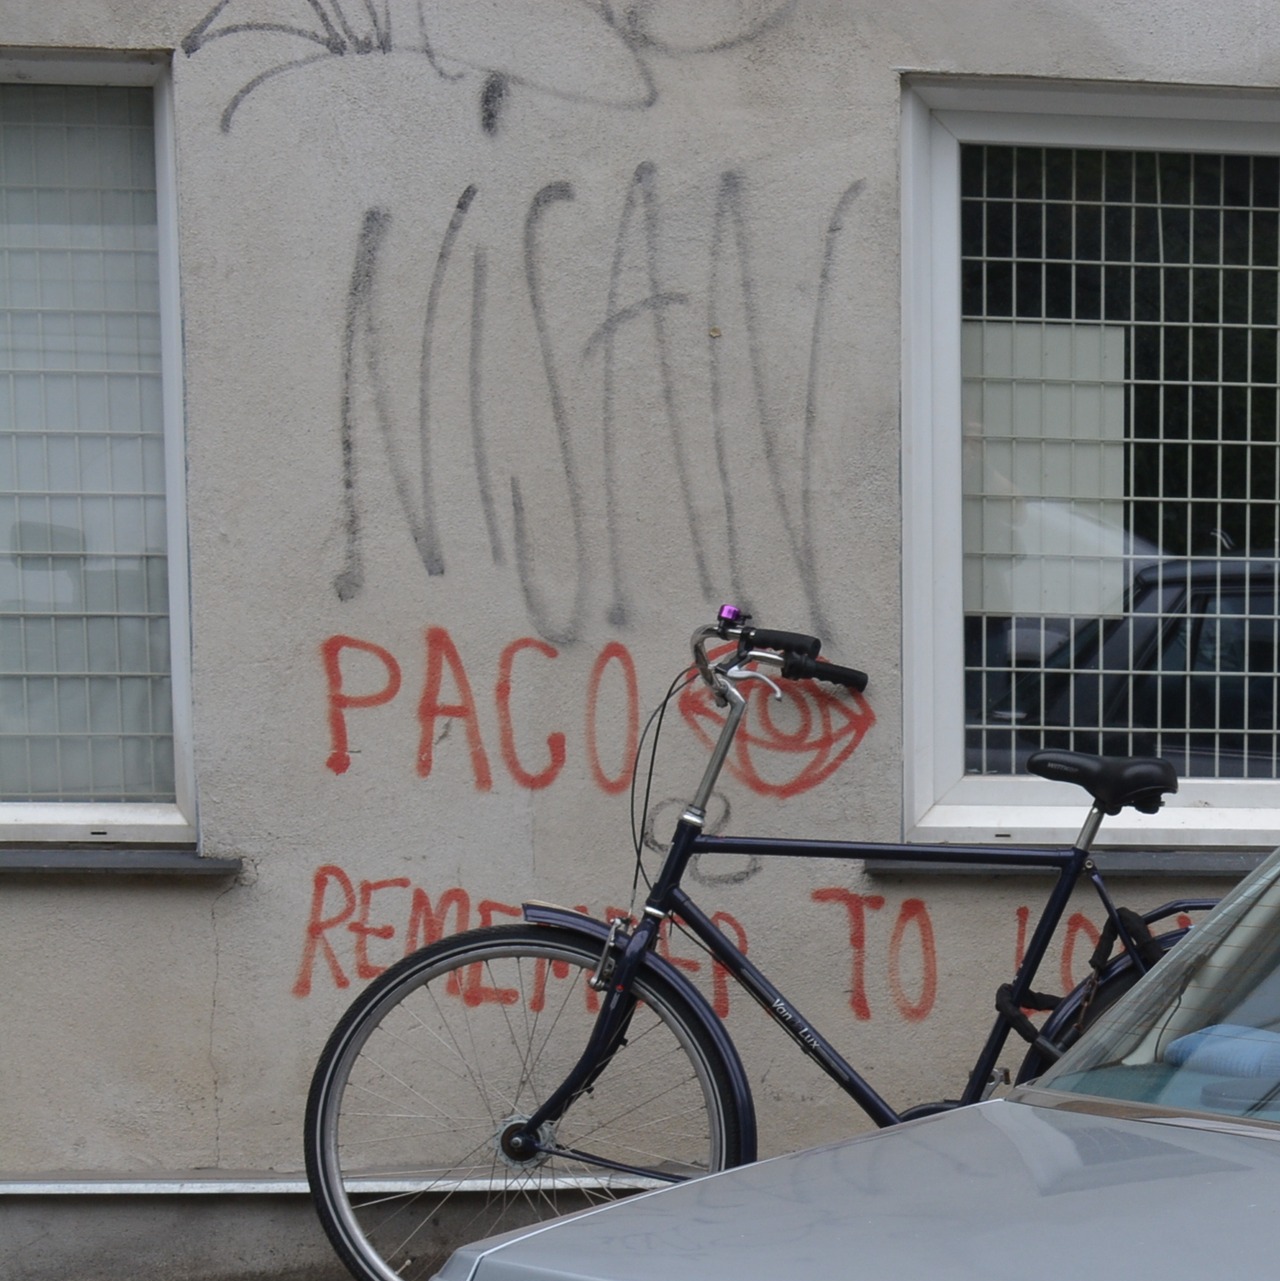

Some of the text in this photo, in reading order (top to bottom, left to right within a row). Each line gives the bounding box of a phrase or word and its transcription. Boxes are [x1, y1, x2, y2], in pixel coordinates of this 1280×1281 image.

[811, 887, 938, 1022] TO
[771, 998, 820, 1049] Van Lux
